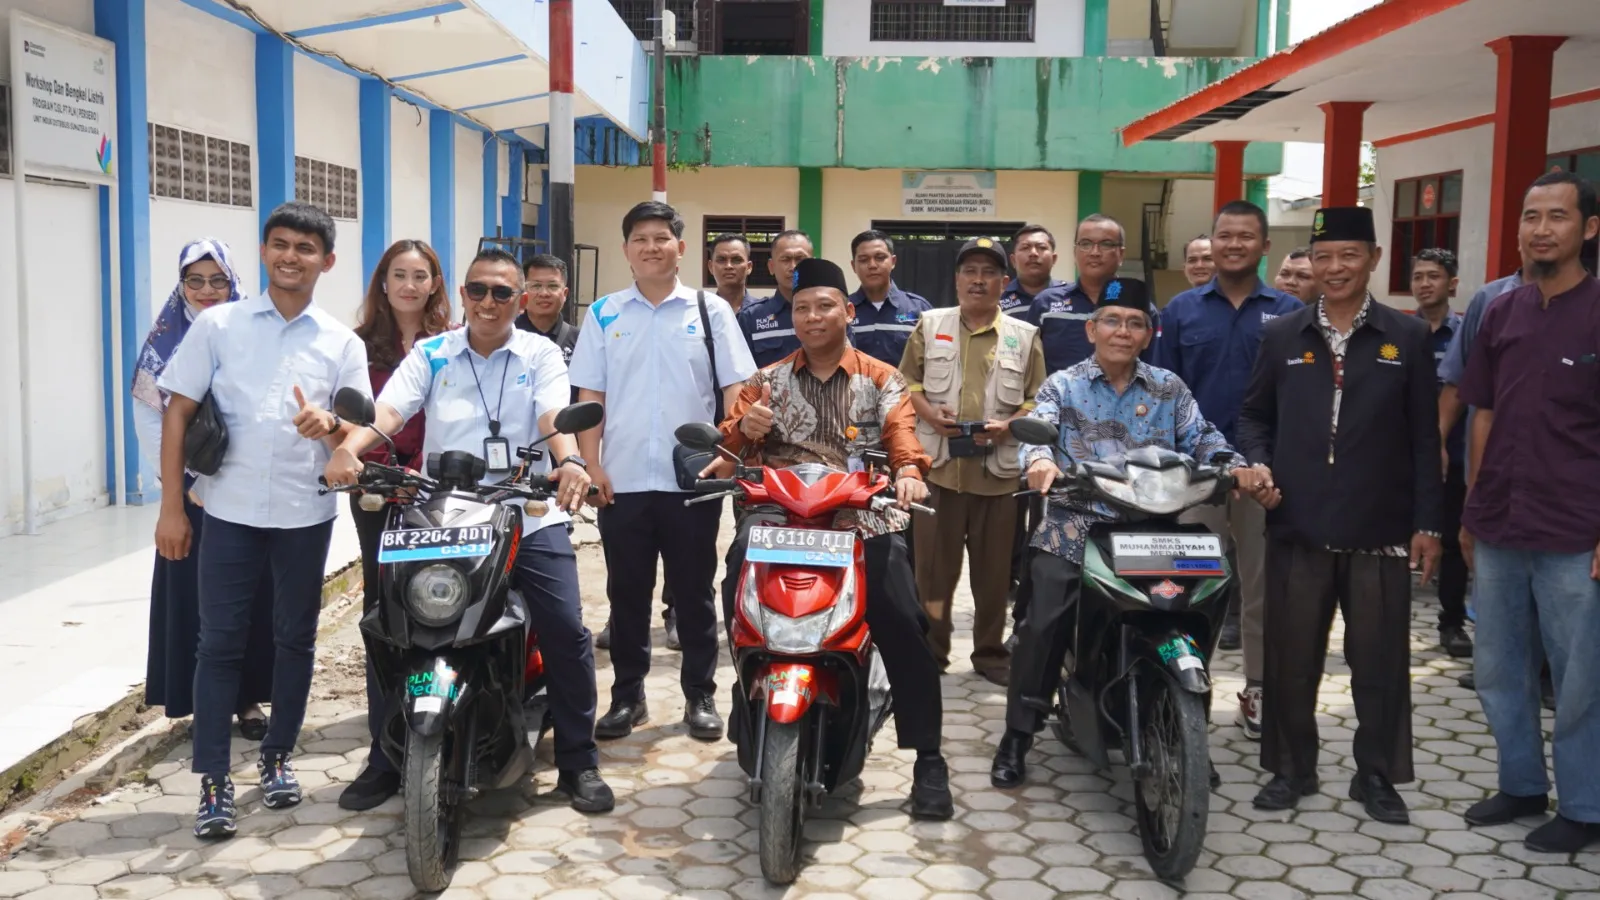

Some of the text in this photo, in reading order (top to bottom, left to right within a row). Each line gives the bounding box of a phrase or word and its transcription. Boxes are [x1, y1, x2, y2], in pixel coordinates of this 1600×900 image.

[25, 71, 105, 105] Workshop Dan Bengkel Listrik
[32, 97, 53, 111] PROGRAM
[756, 320, 779, 330] Peduli
[384, 526, 491, 546] BK 2204 ADT
[752, 528, 773, 543] BK
[776, 530, 816, 546] 6116
